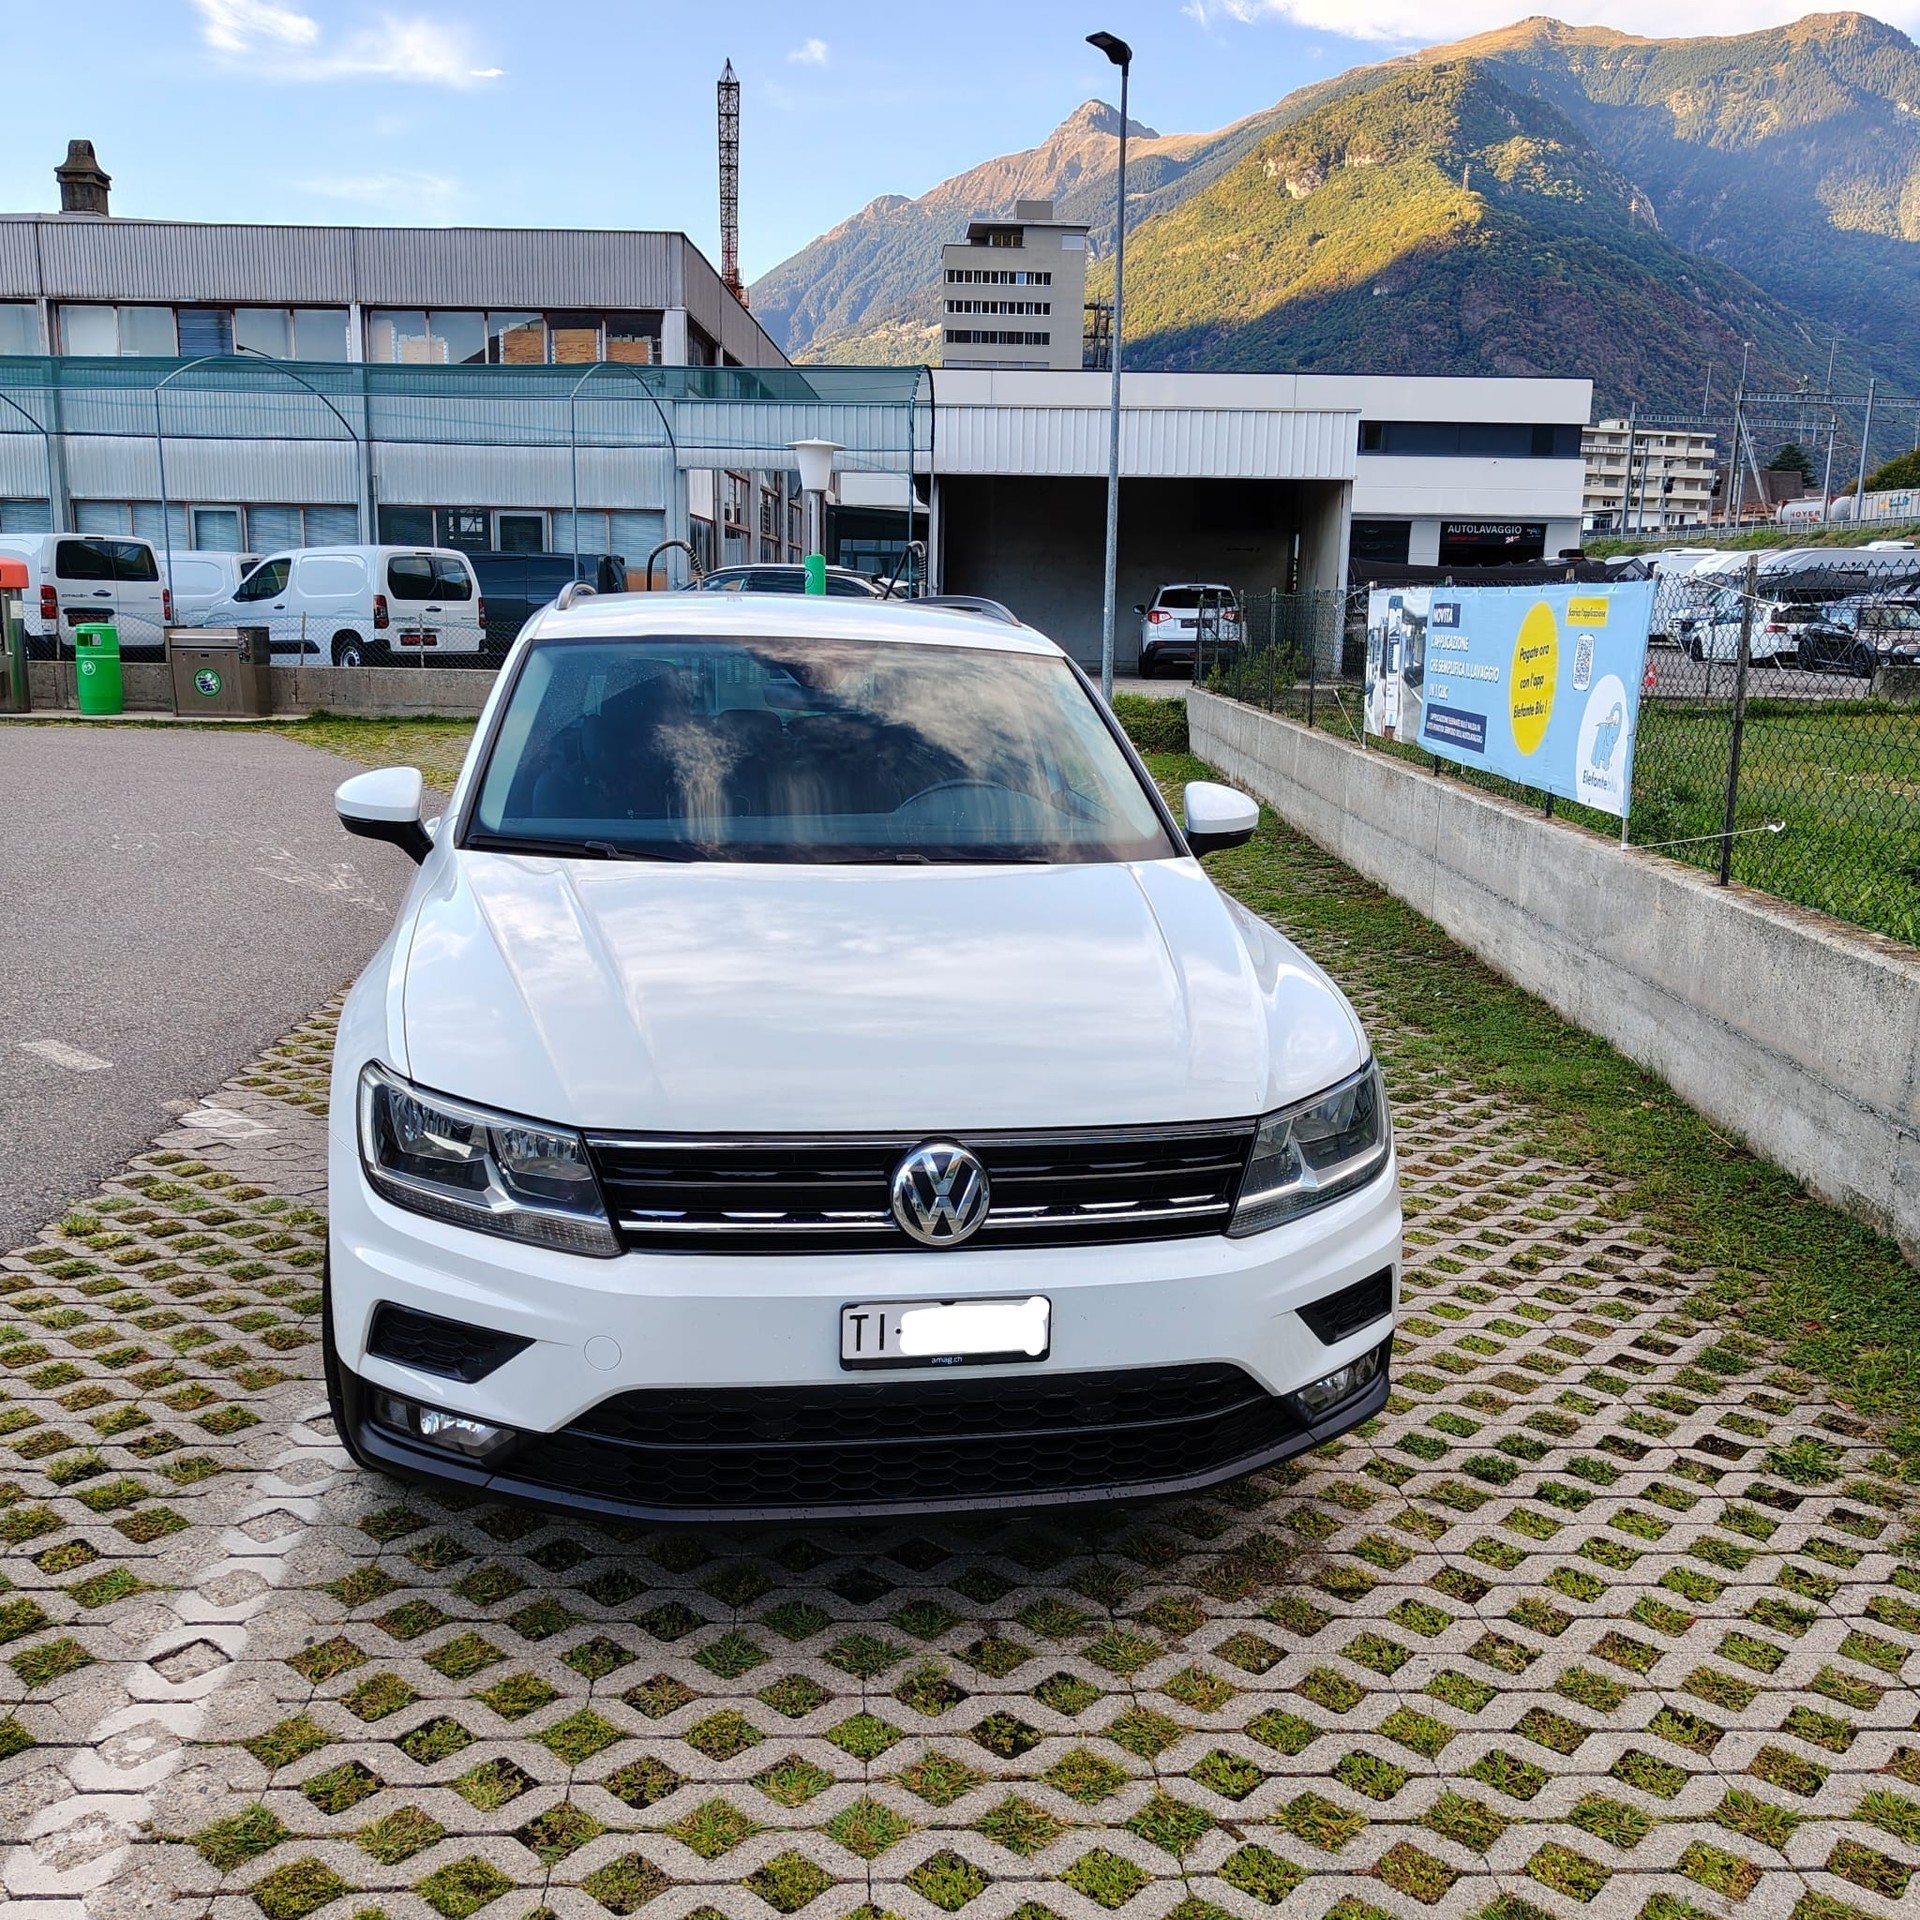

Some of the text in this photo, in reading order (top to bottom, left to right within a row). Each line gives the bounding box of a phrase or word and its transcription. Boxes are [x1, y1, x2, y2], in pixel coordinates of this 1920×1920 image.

[1447, 525, 1522, 534] AUTOLAVAGGIO
[1519, 645, 1550, 663] Pagate ora
[1470, 664, 1500, 683] LAVAGGIO
[1520, 672, 1545, 690] con l'app
[1513, 703, 1535, 718] Elefante
[931, 1356, 963, 1365] amag.ch
